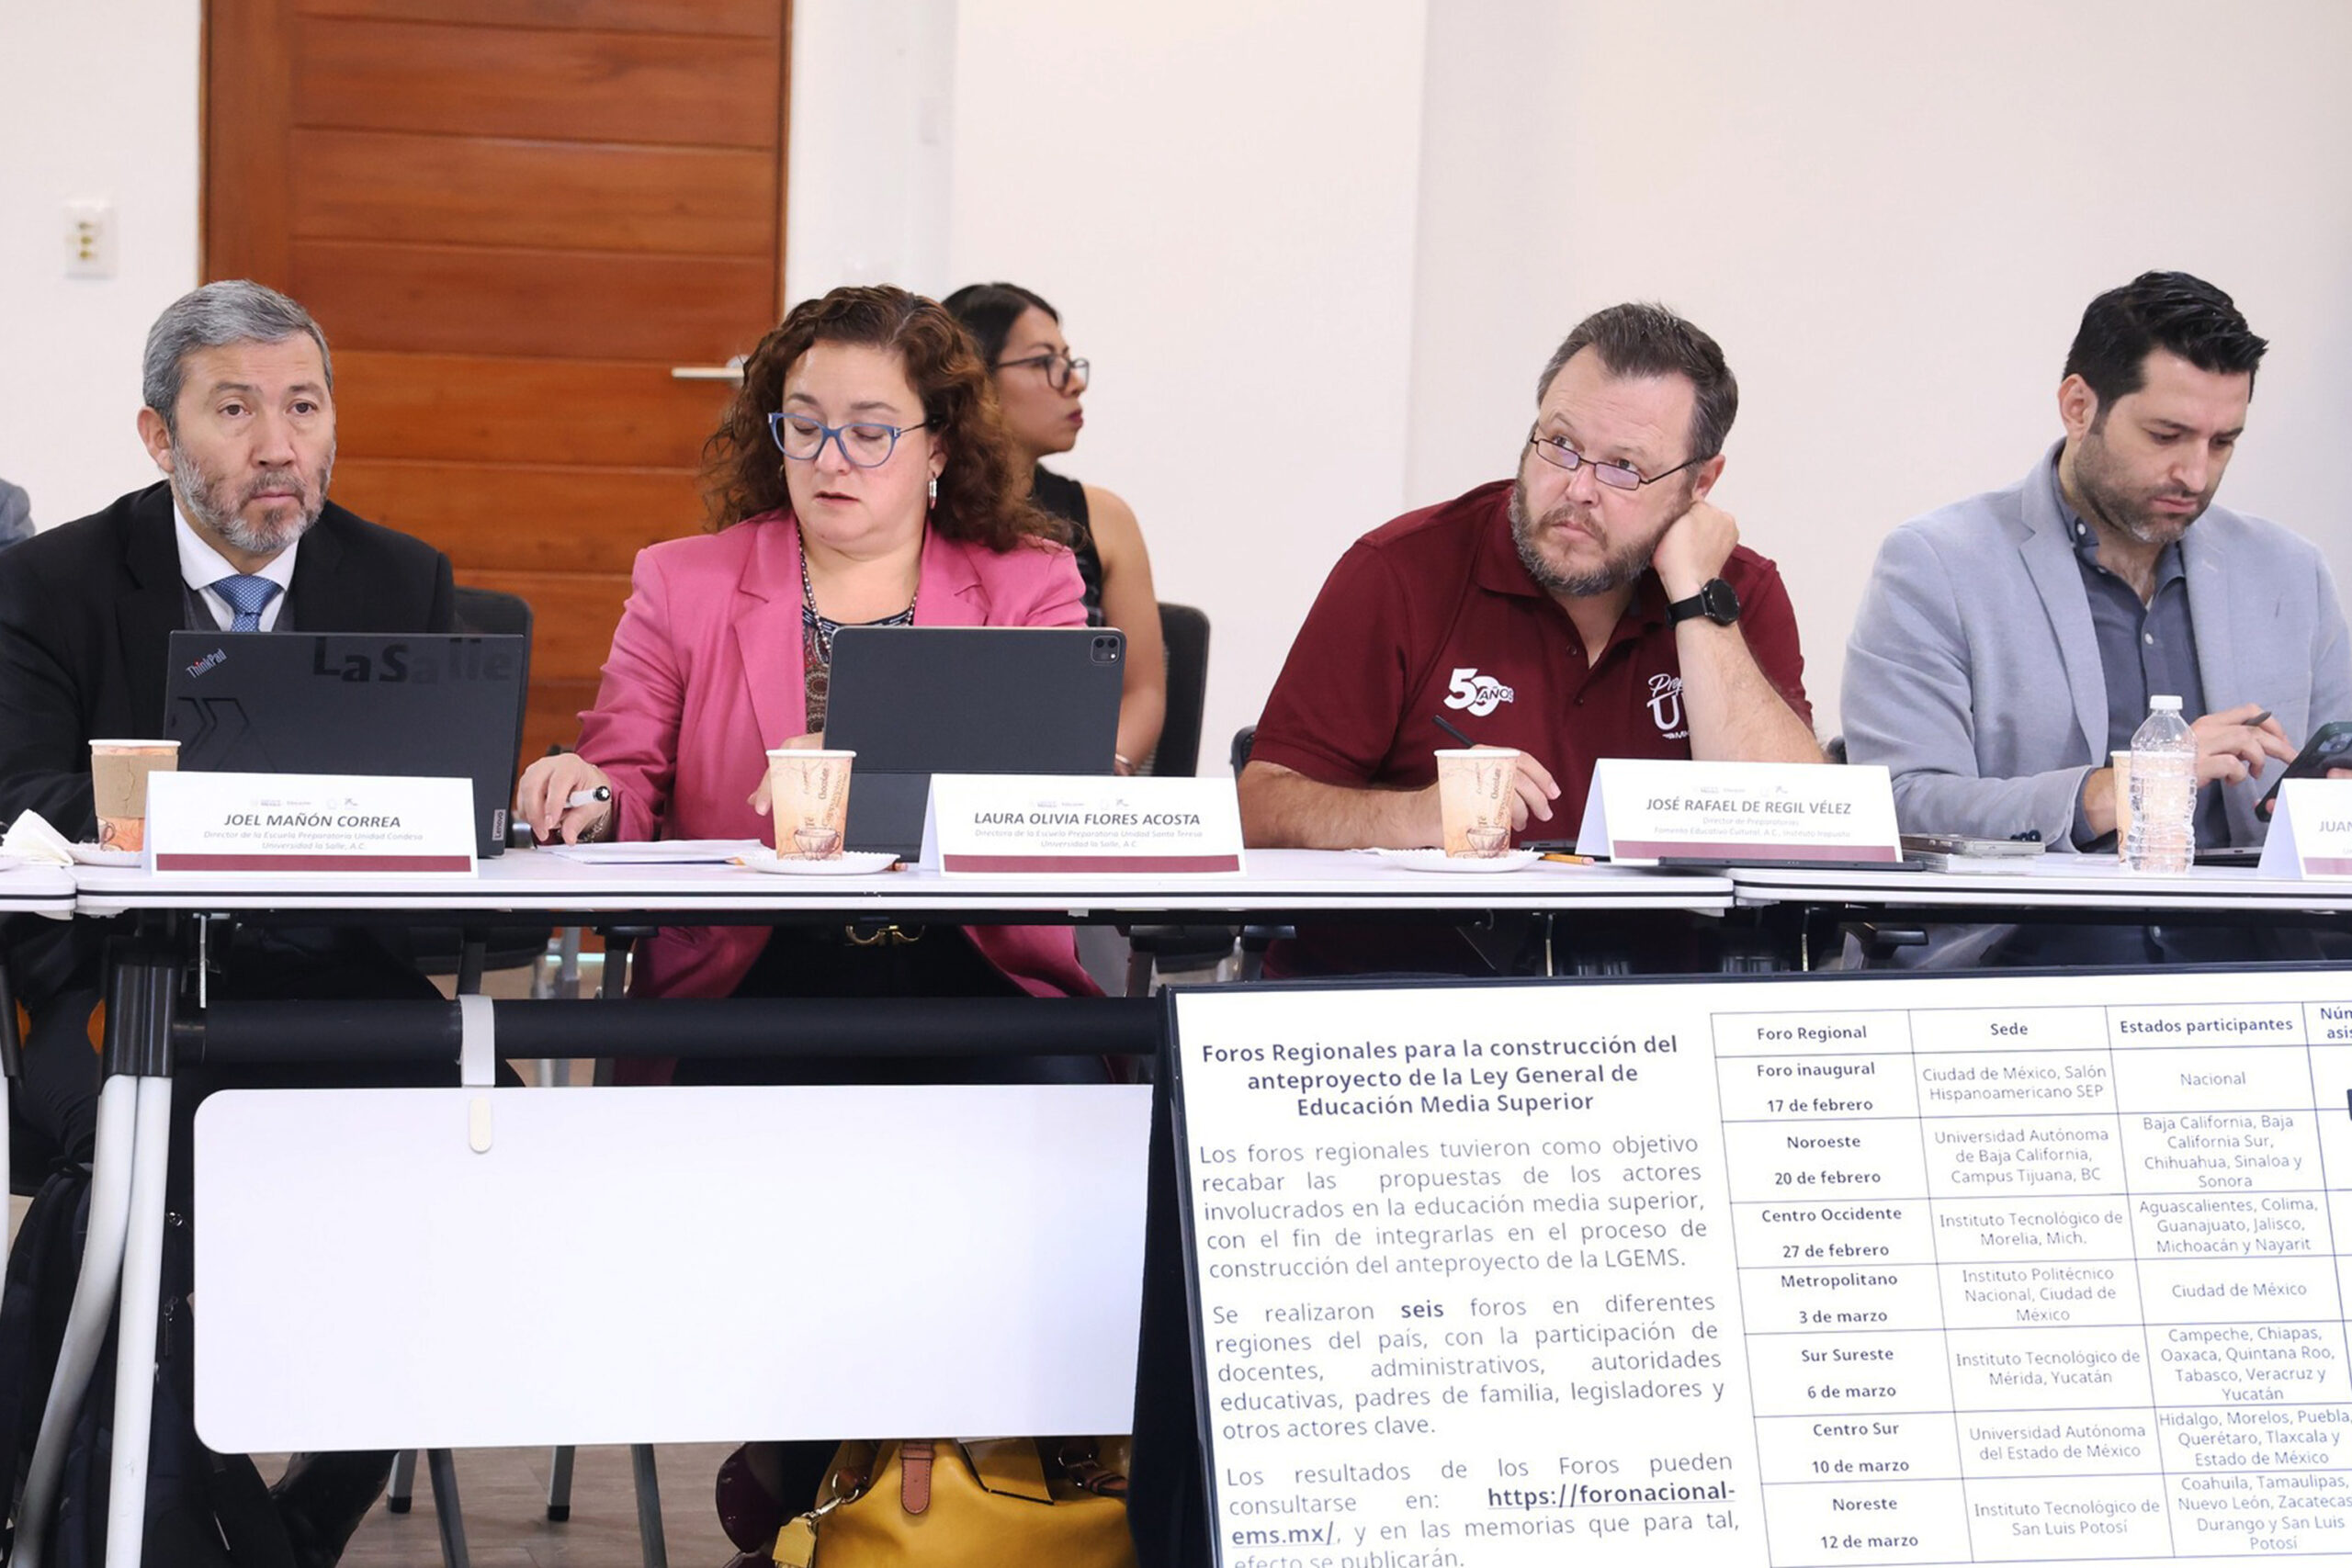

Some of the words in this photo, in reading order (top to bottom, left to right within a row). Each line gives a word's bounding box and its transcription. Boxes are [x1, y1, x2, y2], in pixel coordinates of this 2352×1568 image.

[185, 648, 227, 678] ThinkPad
[1443, 668, 1501, 717] 50
[1476, 685, 1514, 702] AÑOS
[1645, 796, 1680, 811] JOSÉ
[1684, 798, 1737, 812] RAFAEL
[1741, 800, 1760, 813] DE
[1764, 801, 1805, 814] REGIL
[1809, 799, 1852, 815] VÉLEZ
[223, 814, 261, 827] JOEL
[266, 812, 333, 828] MAÑÓN
[336, 815, 401, 829] CORREA
[494, 811, 504, 839] Lenovo
[974, 812, 1024, 825] LAURA
[1029, 812, 1080, 825] OLIVIA
[1084, 813, 1138, 826] FLORES
[1142, 813, 1201, 826] ACOSTA
[204, 831, 238, 840] Director
[240, 831, 252, 840] de
[253, 831, 262, 840] la
[263, 831, 296, 840] Escuela
[298, 831, 353, 842] Preparatoria
[355, 832, 385, 840] Unidad
[1014, 829, 1024, 838] de
[262, 841, 312, 851] Universidad
[314, 841, 323, 851] la
[1757, 1027, 1793, 1041] Foro
[1797, 1024, 1867, 1043] Regional
[1990, 1021, 2029, 1036] Sede
[2120, 1019, 2182, 1034] Estados
[2186, 1017, 2293, 1036] participantes
[1202, 1044, 1265, 1063] Foros
[1272, 1041, 1397, 1066] Regionales
[1404, 1043, 1456, 1065] para
[1463, 1038, 1483, 1057] la
[1489, 1034, 1636, 1057] construcción
[1644, 1034, 1678, 1054] del
[1248, 1070, 1402, 1095] anteproyecto
[1408, 1067, 1436, 1087] de
[1442, 1066, 1463, 1086] la
[1470, 1067, 1509, 1090] Ley
[1515, 1064, 1604, 1084] General
[1611, 1063, 1638, 1082] de
[1757, 1064, 1793, 1077] Foro
[1796, 1061, 1875, 1080] inaugural
[1922, 1066, 1976, 1082] Ciudad
[1979, 1066, 1999, 1081] de
[2003, 1065, 2061, 1080] México,
[2064, 1064, 2107, 1079] Salón
[2180, 1070, 2246, 1087] Nacional
[1929, 1086, 2074, 1104] Hispanoamericano
[2075, 1083, 2104, 1099] SEP
[1297, 1094, 1413, 1117] Educación
[1420, 1094, 1490, 1113] Media
[1497, 1091, 1594, 1117] Superior
[1767, 1099, 1784, 1113] 17
[1788, 1098, 1808, 1112] de
[1812, 1098, 1873, 1112] febrero
[1786, 1135, 1861, 1149] Noroeste
[1934, 1128, 2026, 1145] Universidad
[2029, 1127, 2109, 1143] Autónoma
[1955, 1149, 1974, 1164] de
[1978, 1148, 2012, 1167] Baja
[2015, 1146, 2093, 1163] California,
[1774, 1171, 1792, 1186] 20
[1796, 1170, 1816, 1185] de
[1820, 1169, 1882, 1185] febrero
[1951, 1169, 2014, 1187] Campus
[2016, 1168, 2077, 1187] Tijuana,
[2080, 1167, 2101, 1181] BC
[1761, 1209, 1817, 1224] Centro
[1820, 1206, 1902, 1222] Occidente
[2139, 1198, 2257, 1218] Aguascalientes,
[2260, 1197, 2319, 1212] Colima,
[1939, 1213, 2006, 1228] Instituto
[2007, 1211, 2100, 1229] Tecnológico
[2103, 1210, 2123, 1224] de
[1980, 1231, 2042, 1247] Morelia,
[2046, 1227, 2087, 1245] Mich.
[1782, 1245, 1800, 1258] 27
[1804, 1244, 1825, 1258] de
[1828, 1243, 1890, 1258] febrero
[1209, 1255, 1349, 1279] construcción
[1355, 1255, 1388, 1275] del
[1396, 1254, 1540, 1279] anteproyecto
[1546, 1249, 1573, 1269] de
[1579, 1249, 1599, 1269] la
[1604, 1247, 1686, 1269] LGEMS.
[1781, 1272, 1898, 1291] Metropolitano
[1799, 1310, 1808, 1325] 3
[1812, 1309, 1832, 1324] de
[1837, 1311, 1888, 1323] marzo
[1801, 1348, 1828, 1363] Sur
[1832, 1348, 1894, 1362] Sureste
[1807, 1385, 1817, 1400] 6
[1820, 1384, 1840, 1399] de
[1845, 1386, 1897, 1398] marzo
[1813, 1423, 1869, 1438] Centro
[1872, 1421, 1900, 1436] Sur
[1812, 1460, 1830, 1474] 10
[1834, 1459, 1854, 1473] de
[1859, 1461, 1910, 1472] marzo
[2180, 1474, 2253, 1492] Coahuila,
[2256, 1473, 2349, 1492] Tamaulipas,
[1229, 1495, 1357, 1516] consultarse
[1406, 1495, 1439, 1509] en:
[1487, 1480, 1736, 1512] https://foronacional-
[1832, 1498, 1898, 1512] Noreste
[2177, 1497, 2228, 1511] Nuevo
[2232, 1495, 2275, 1511] León,
[1231, 1520, 1341, 1546] ems.mx/,
[1353, 1527, 1366, 1548] y
[1380, 1525, 1408, 1540] en
[1420, 1519, 1451, 1539] las
[1464, 1515, 1576, 1537] memorias
[1589, 1517, 1630, 1539] que
[1644, 1515, 1693, 1538] para
[1705, 1509, 1739, 1531] tal,
[1820, 1535, 1838, 1550] 12
[1842, 1534, 1862, 1549] de
[1867, 1536, 1919, 1548] marzo
[1309, 1557, 1334, 1568] se
